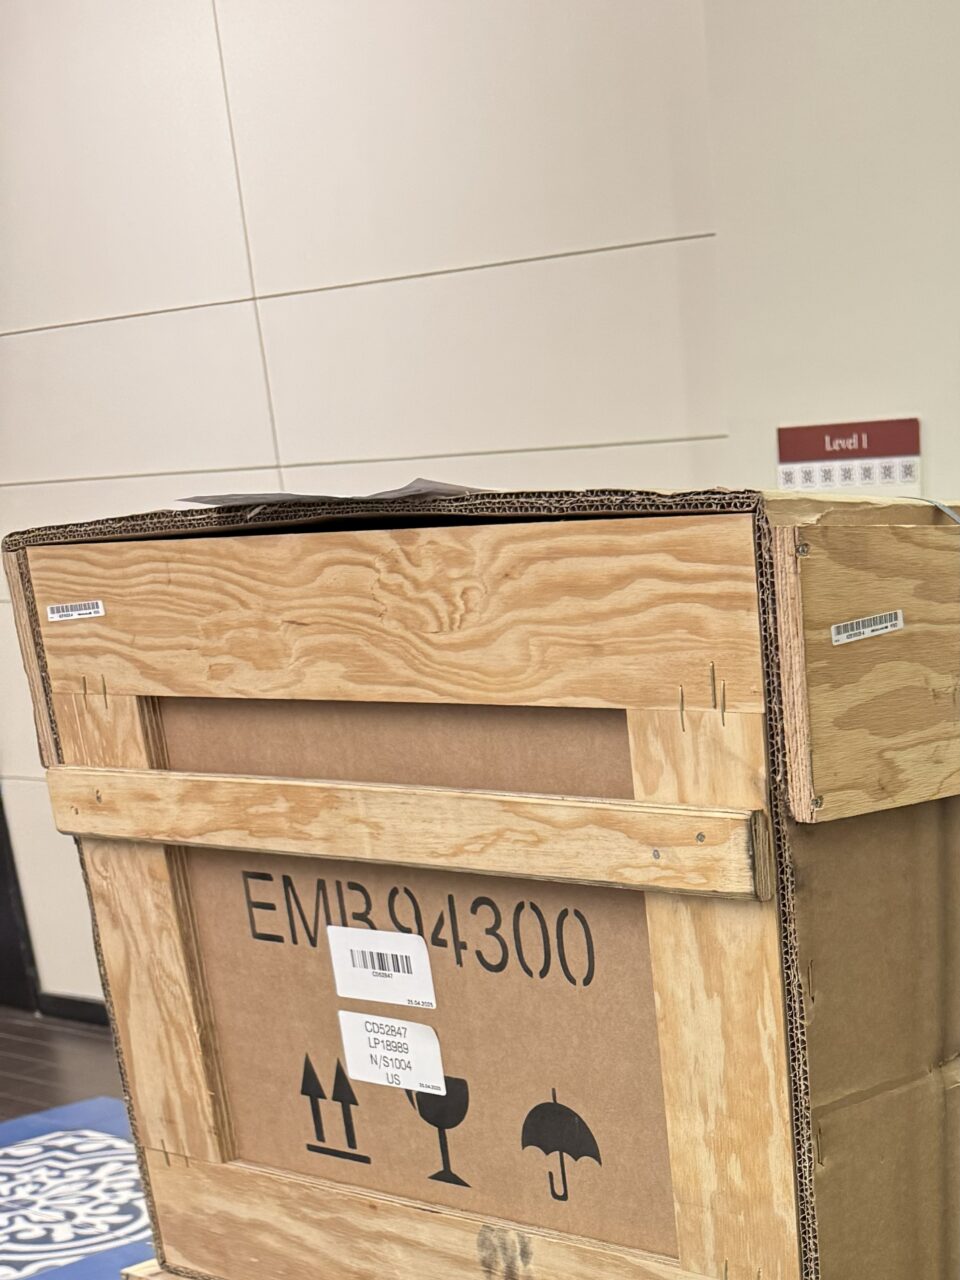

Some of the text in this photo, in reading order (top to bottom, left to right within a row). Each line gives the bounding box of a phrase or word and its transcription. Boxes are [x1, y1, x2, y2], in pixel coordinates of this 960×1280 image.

[825, 434, 858, 451] Level
[364, 1021, 407, 1038] CD52847
[368, 1037, 409, 1055] LP18989
[386, 1072, 401, 1086] US
